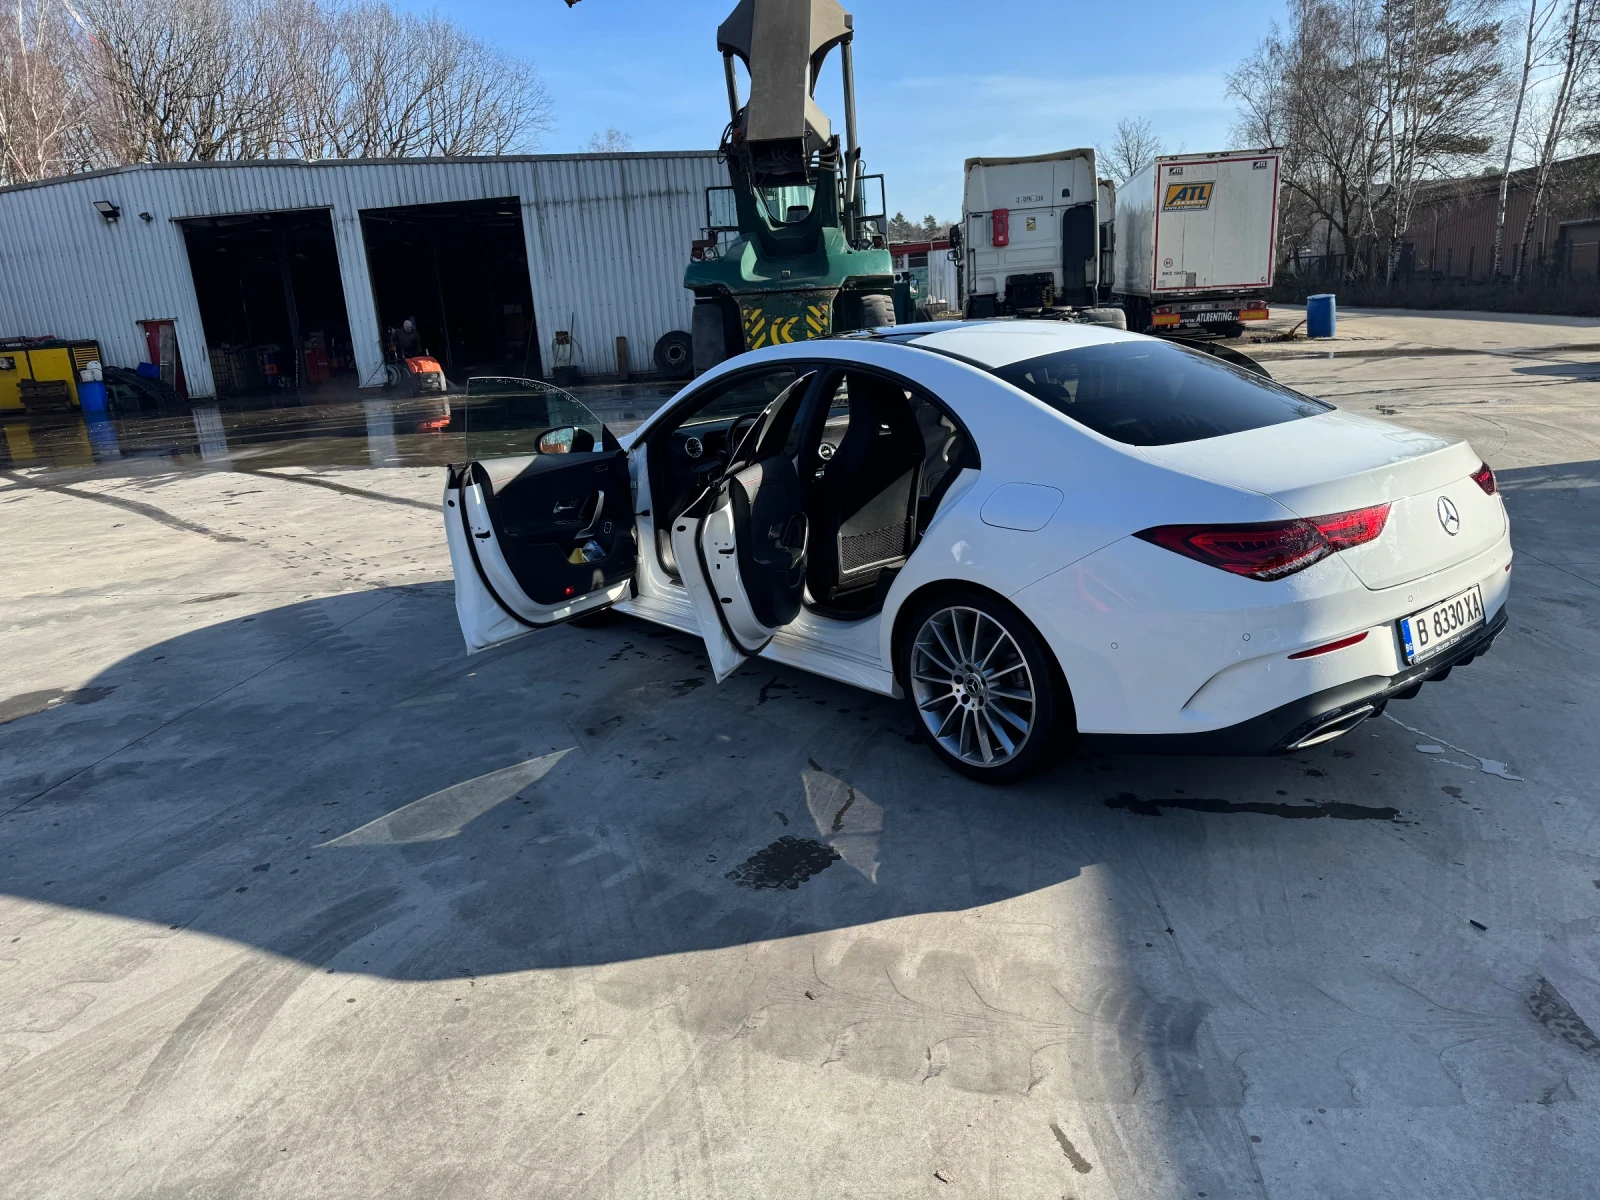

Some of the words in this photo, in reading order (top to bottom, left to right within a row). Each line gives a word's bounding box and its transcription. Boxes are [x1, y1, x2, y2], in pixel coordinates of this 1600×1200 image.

[1168, 186, 1207, 205] ATL
[1416, 618, 1429, 647] B
[1433, 600, 1464, 637] 8330
[1463, 592, 1481, 623] XA
[1405, 642, 1413, 652] BG
